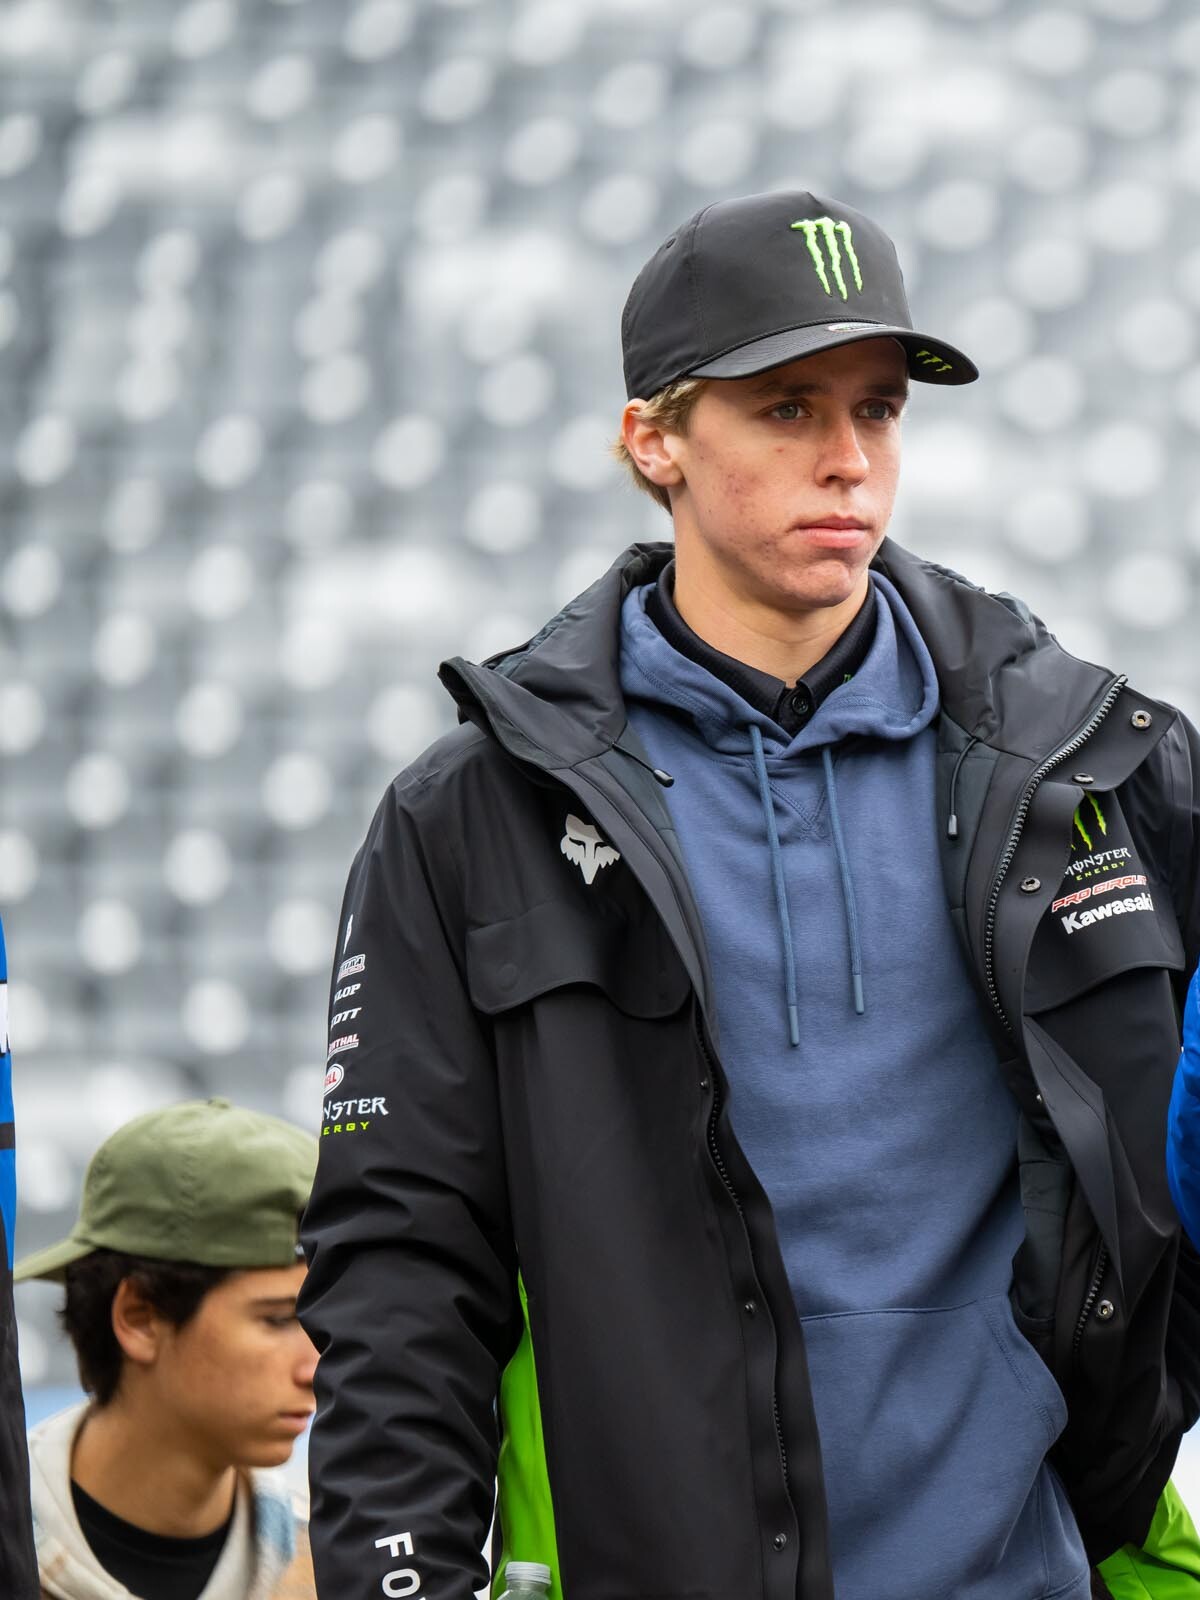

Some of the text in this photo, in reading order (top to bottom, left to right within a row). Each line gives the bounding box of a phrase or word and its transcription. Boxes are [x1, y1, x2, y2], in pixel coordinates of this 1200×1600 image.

[1076, 861, 1126, 881] ENERGY
[1051, 887, 1092, 913] PRO
[330, 1007, 362, 1030] OTT
[323, 1097, 389, 1121] NSTER
[323, 1121, 370, 1136] ERGY
[375, 1532, 426, 1600] FO
